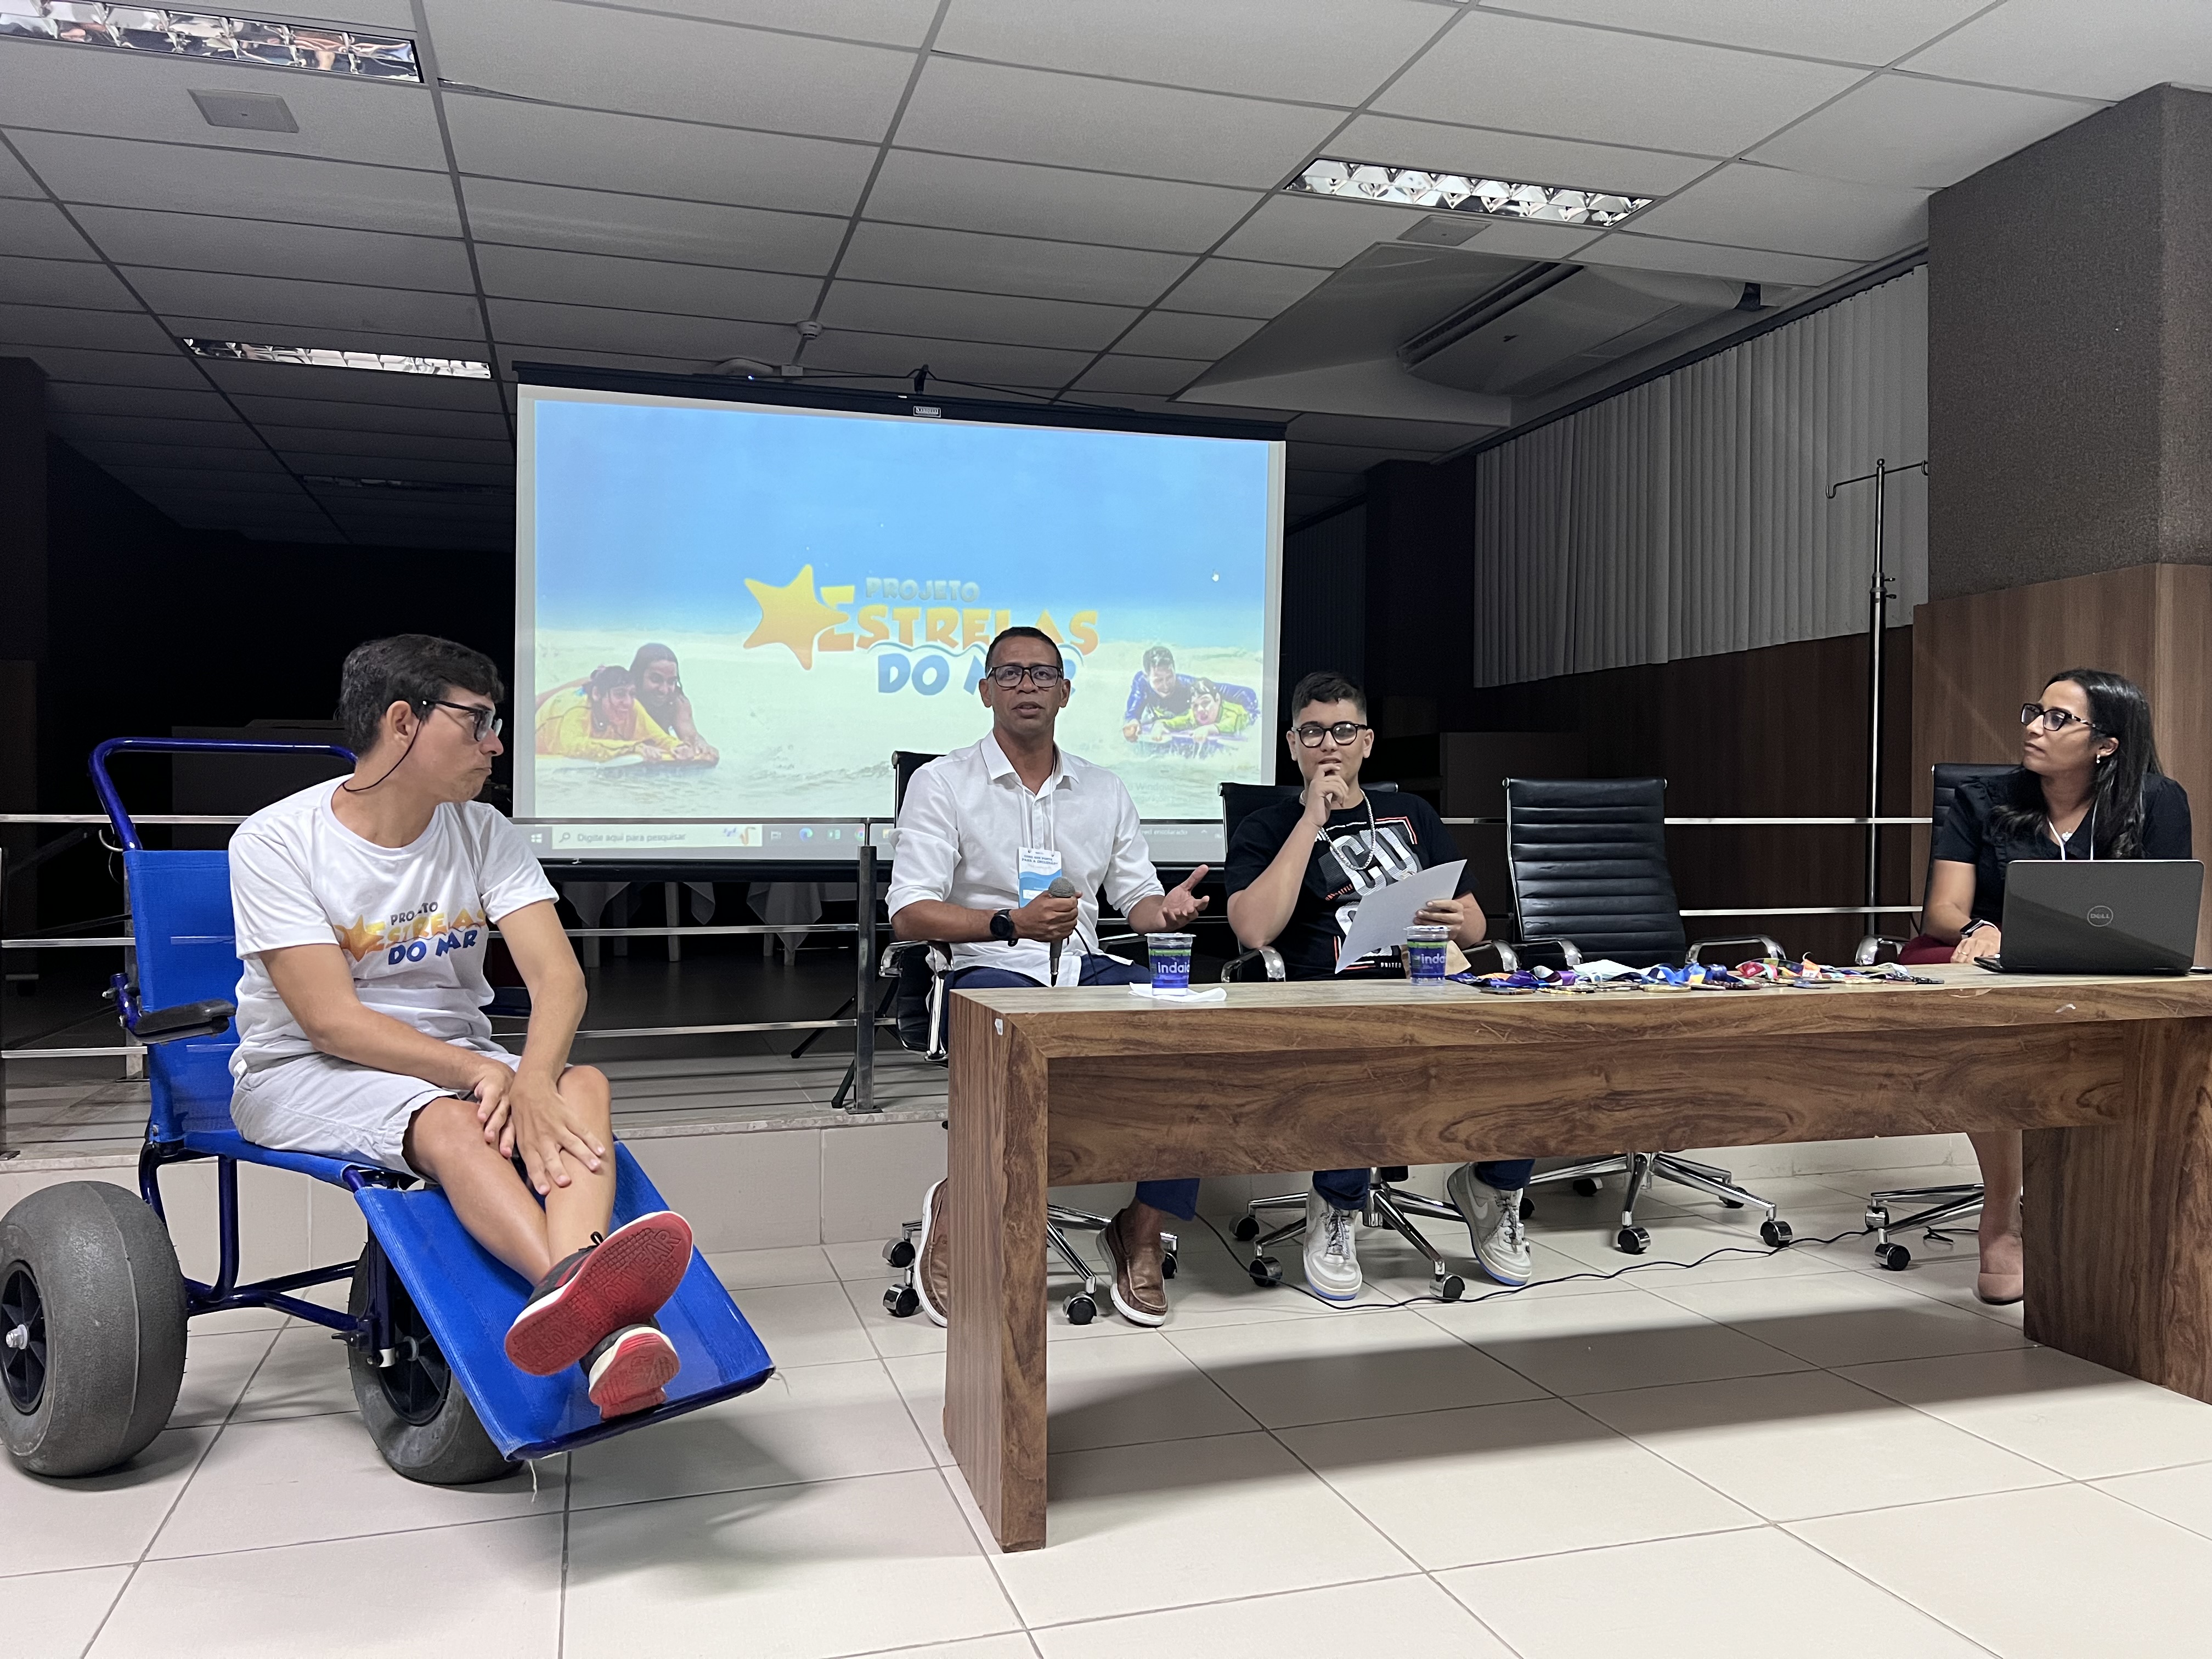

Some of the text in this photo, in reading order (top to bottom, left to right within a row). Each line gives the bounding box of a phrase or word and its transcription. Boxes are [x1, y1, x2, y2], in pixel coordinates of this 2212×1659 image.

[866, 577, 980, 602] PROJETO
[878, 653, 950, 696] DO
[577, 833, 603, 843] Digite
[606, 834, 624, 843] aqui
[646, 833, 686, 842] pesquisar
[390, 901, 438, 926] PROTO
[388, 941, 426, 965] DO
